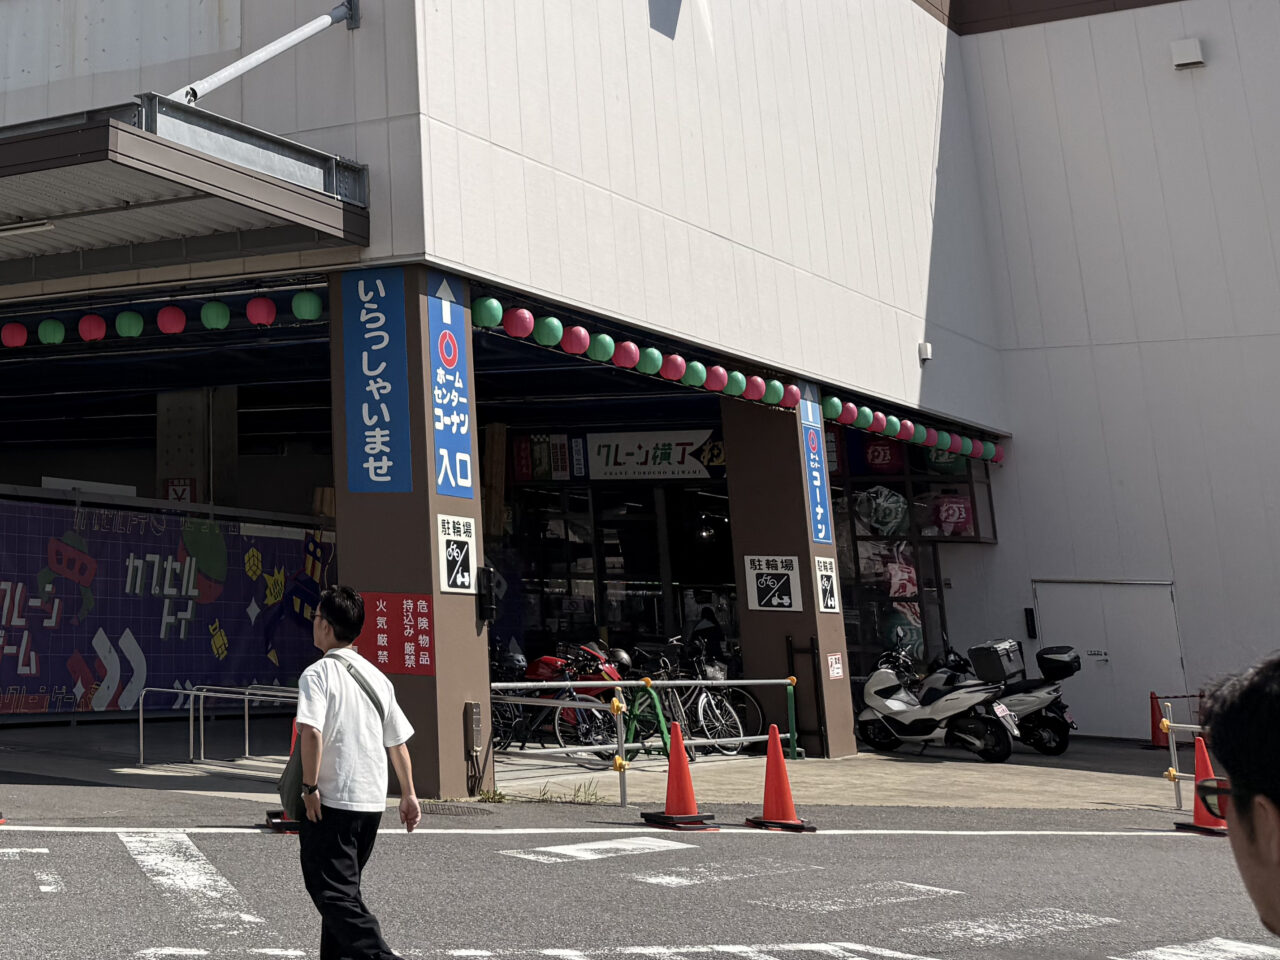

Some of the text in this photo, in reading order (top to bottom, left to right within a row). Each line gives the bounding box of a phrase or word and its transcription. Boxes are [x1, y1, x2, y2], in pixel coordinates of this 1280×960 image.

[357, 278, 393, 482] いらっしゃいませ
[433, 386, 468, 405] センター
[436, 368, 463, 388] ホーム
[434, 409, 470, 435] コーナン
[437, 447, 472, 489] 入口
[597, 442, 694, 467] クレーン横丁
[812, 471, 826, 539] コーナン
[441, 519, 473, 539] 駐輪場
[125, 552, 200, 597] カプセル
[749, 556, 795, 572] 駐輪場
[159, 598, 194, 639] トイ
[376, 598, 389, 664] 火気厳禁
[417, 600, 430, 665] 危険物品
